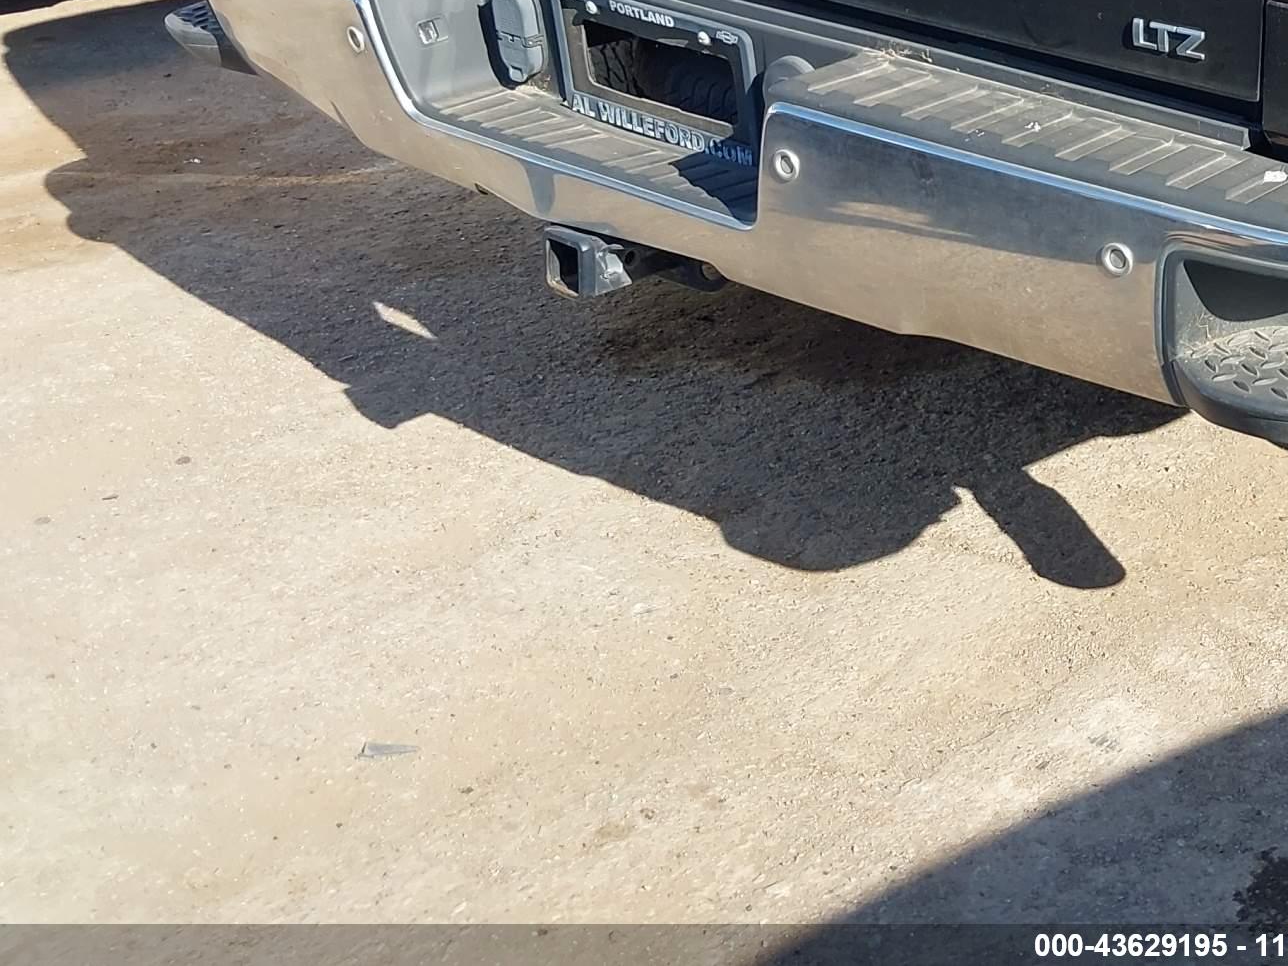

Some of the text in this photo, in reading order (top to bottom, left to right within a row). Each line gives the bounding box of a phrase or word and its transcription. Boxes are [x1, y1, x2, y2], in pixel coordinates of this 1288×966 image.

[608, 0, 675, 28] PORTLAND
[1132, 17, 1206, 61] LTZ
[571, 93, 596, 117] AL
